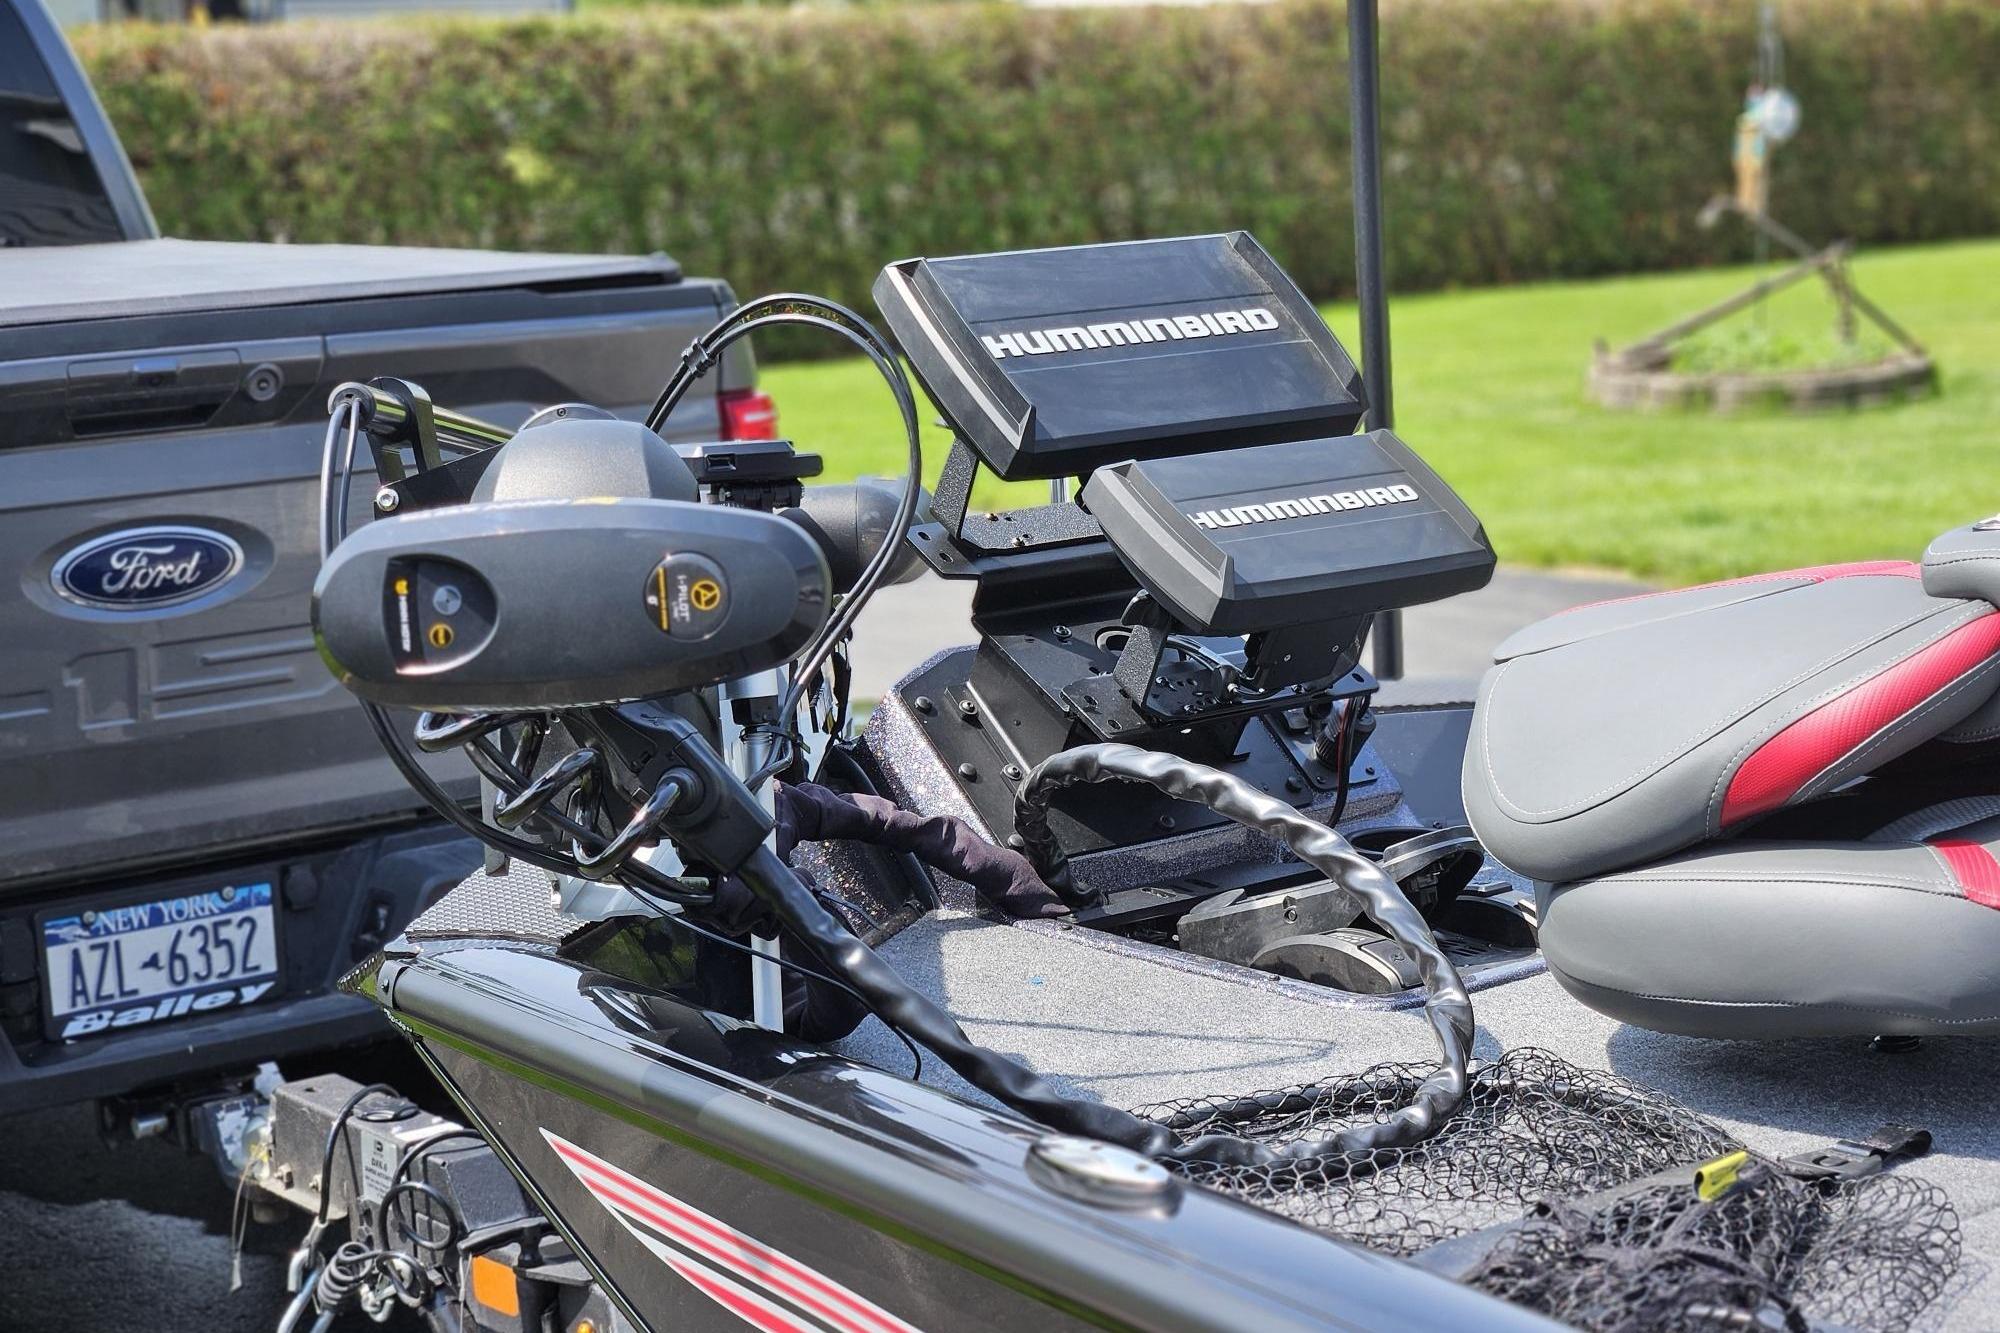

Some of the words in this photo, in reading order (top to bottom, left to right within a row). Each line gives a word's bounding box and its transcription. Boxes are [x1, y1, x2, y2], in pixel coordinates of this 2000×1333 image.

[980, 308, 1279, 359] HUMMINBIRD
[1187, 484, 1420, 530] HUMMINBIRD
[102, 545, 201, 593] Ford
[99, 903, 151, 935] NEW
[159, 891, 220, 923] YORK
[70, 938, 139, 1009] AZL
[168, 915, 261, 987] 6352
